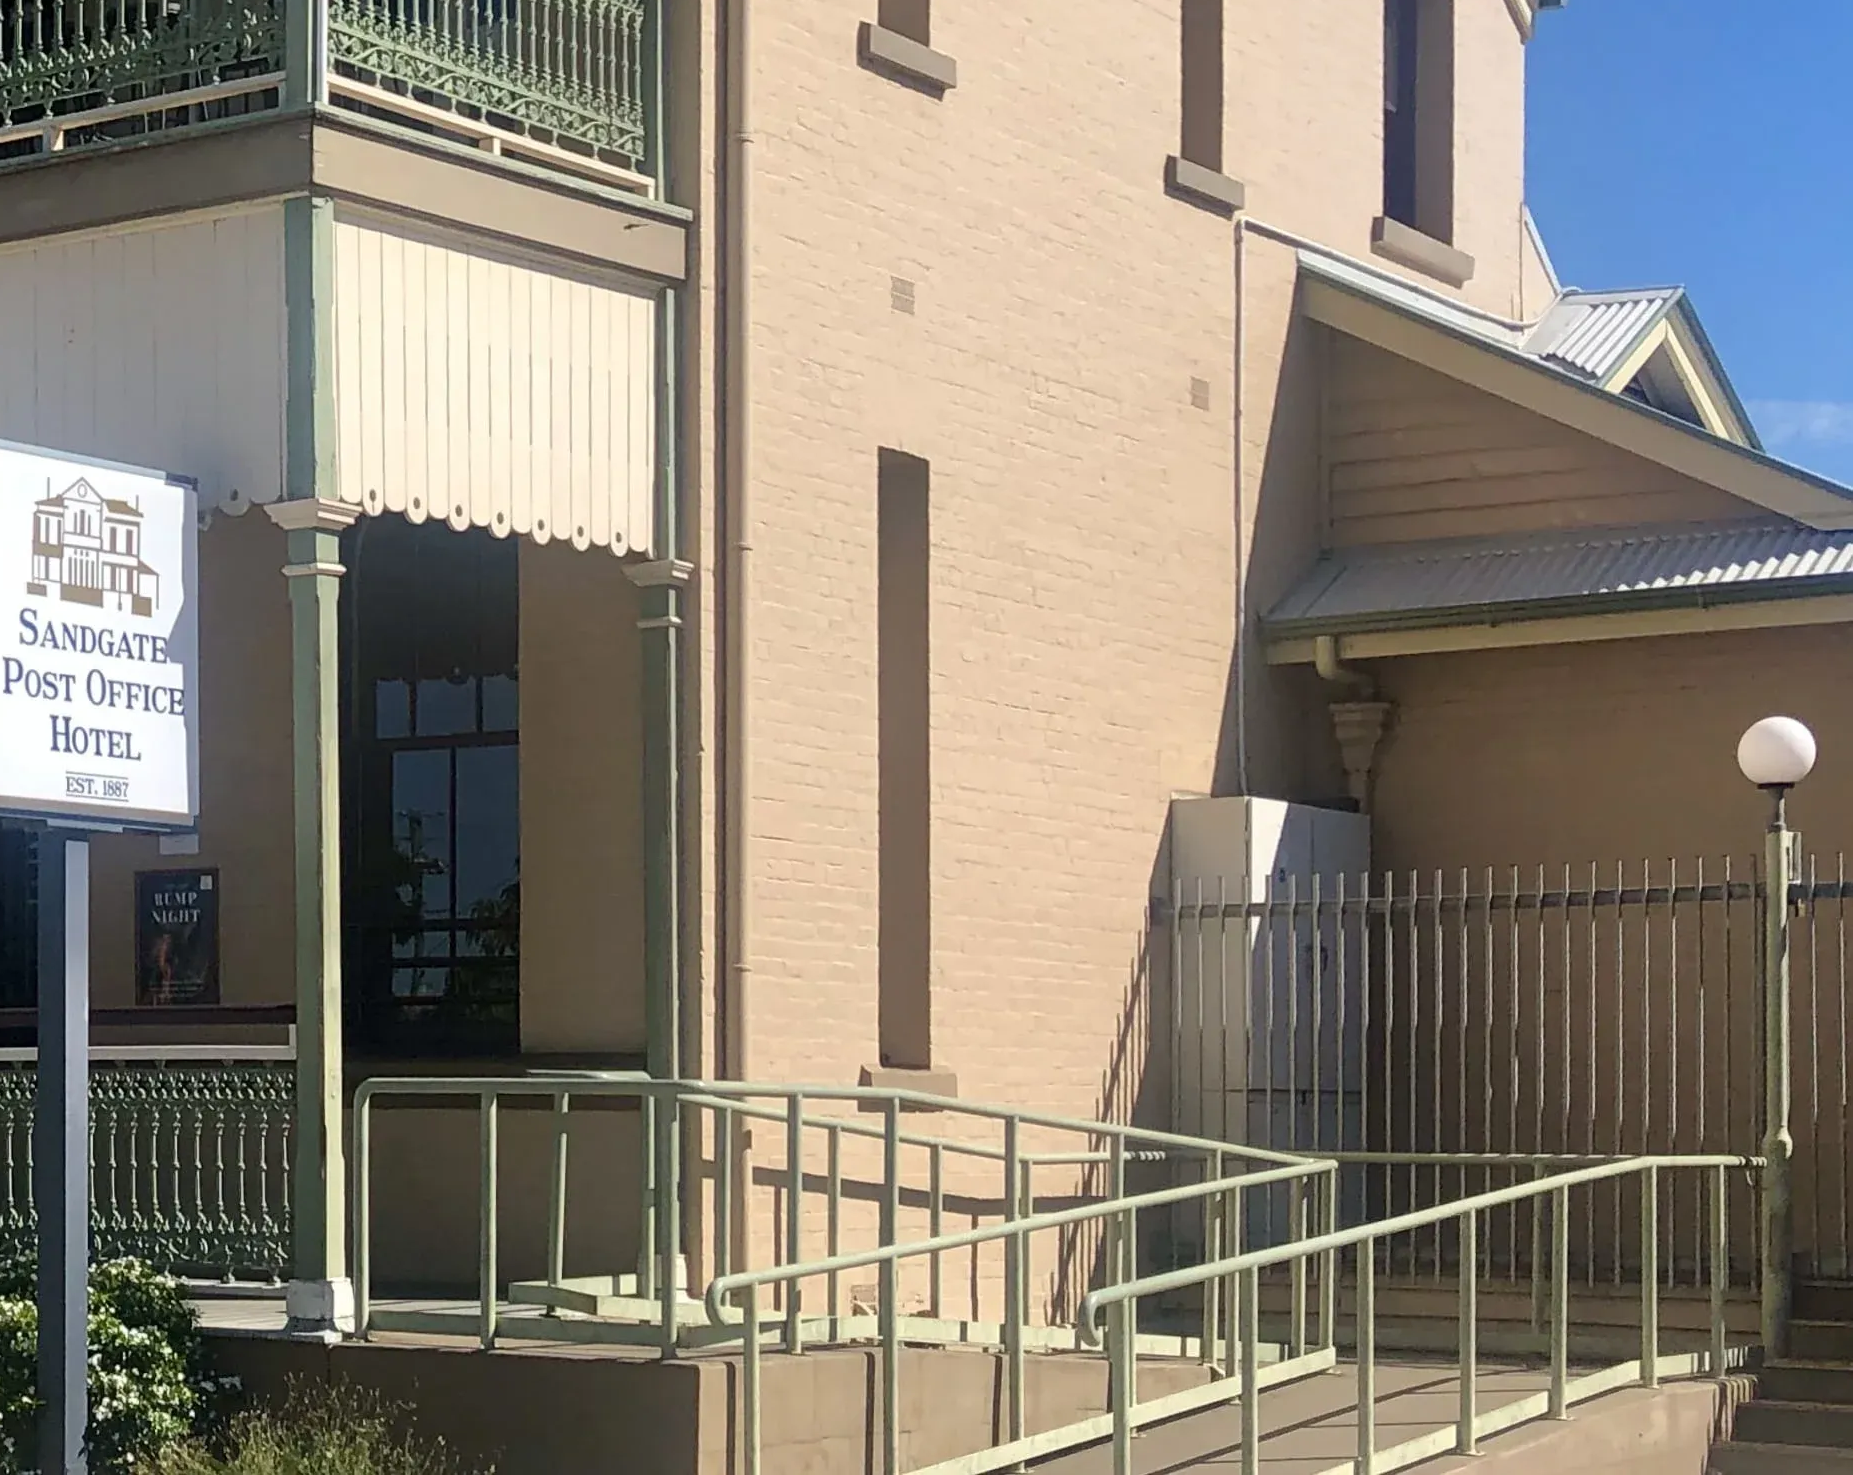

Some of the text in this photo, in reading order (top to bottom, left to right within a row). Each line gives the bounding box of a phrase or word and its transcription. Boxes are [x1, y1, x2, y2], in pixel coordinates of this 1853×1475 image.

[19, 608, 169, 664] SANDGATE
[2, 656, 185, 716] POST OFFICE
[49, 715, 142, 762] HOTEL
[65, 775, 129, 799] EST. 1887
[151, 908, 201, 924] NIGHT
